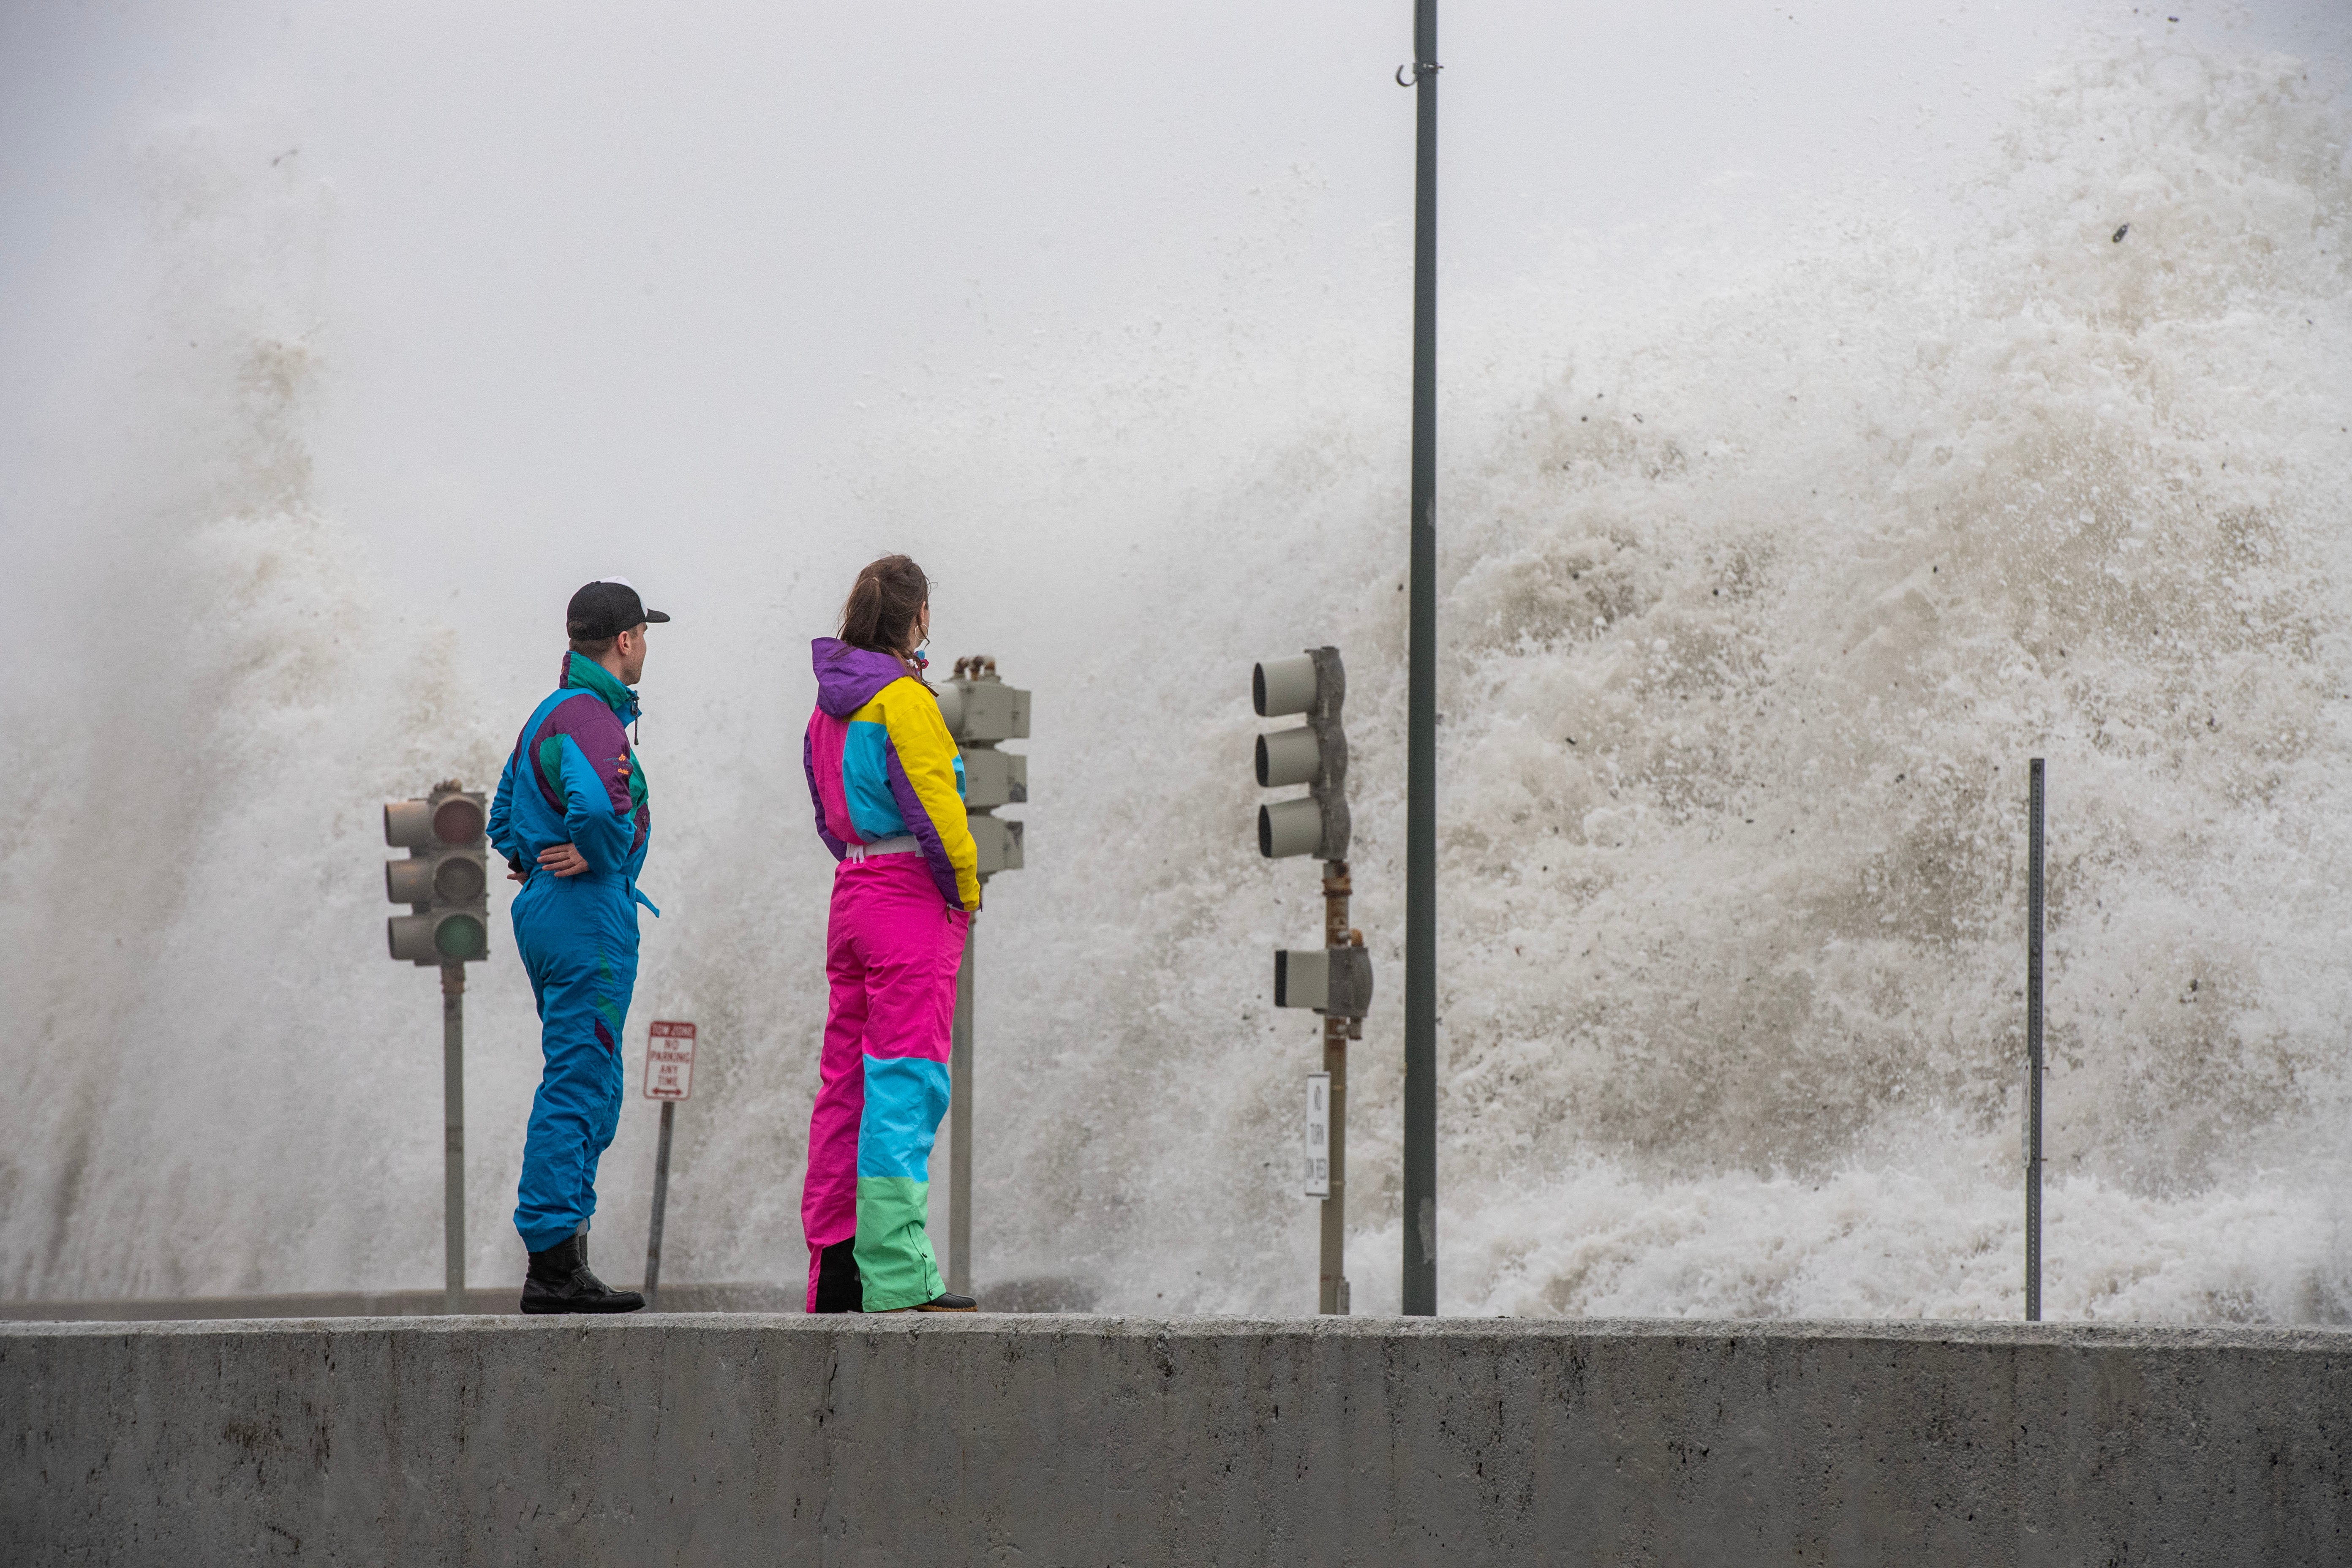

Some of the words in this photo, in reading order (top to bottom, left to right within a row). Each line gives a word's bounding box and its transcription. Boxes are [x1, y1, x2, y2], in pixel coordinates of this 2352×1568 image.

[653, 1024, 670, 1035] TOW
[671, 1025, 694, 1037] ZONE
[664, 1039, 679, 1050] NO
[650, 1051, 690, 1064] PARKING
[659, 1065, 678, 1074] ANY
[658, 1075, 678, 1086] TIME
